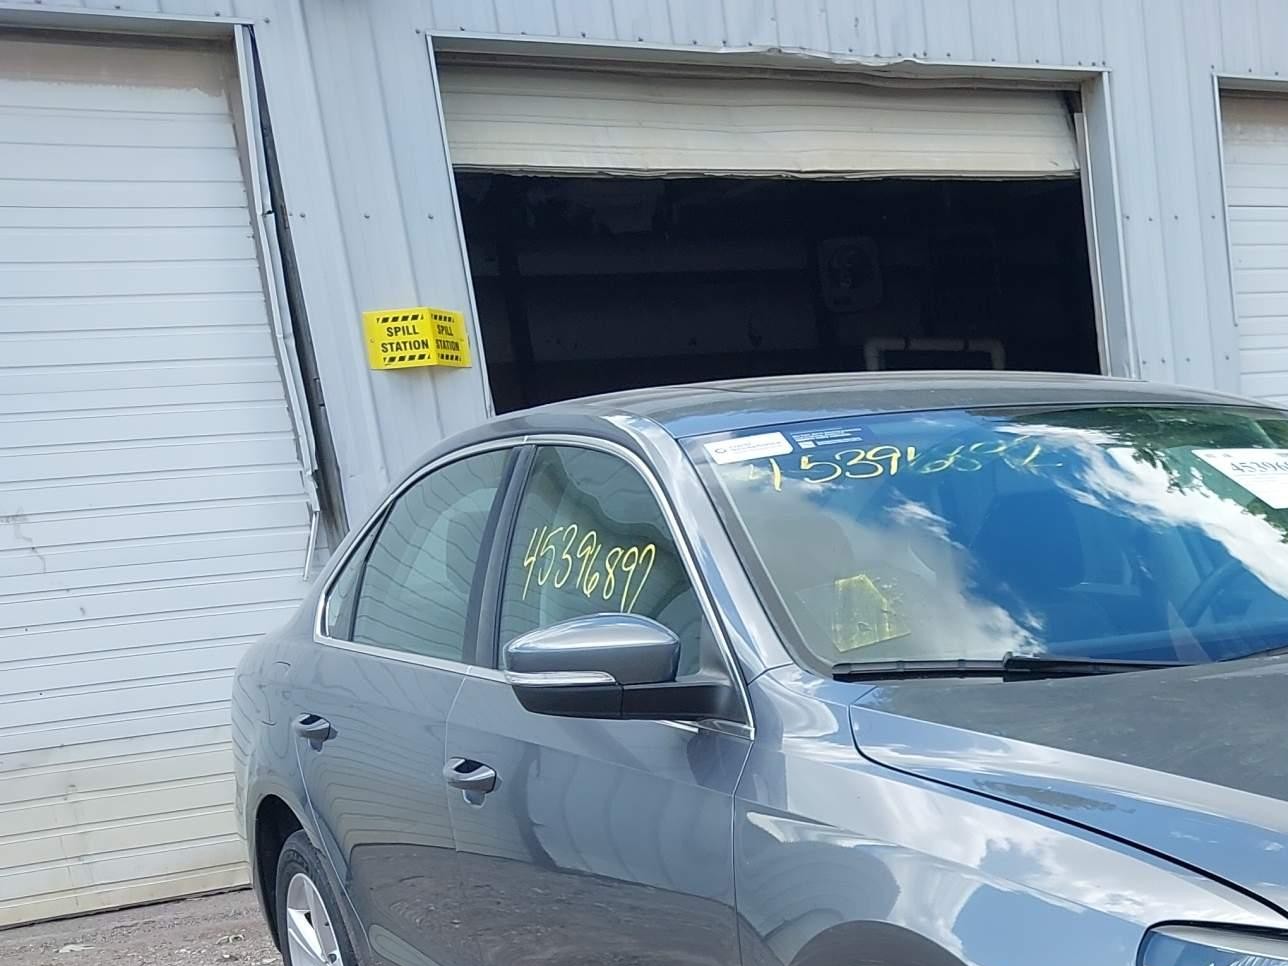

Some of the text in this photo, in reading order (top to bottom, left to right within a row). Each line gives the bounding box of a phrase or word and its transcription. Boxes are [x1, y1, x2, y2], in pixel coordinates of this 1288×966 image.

[386, 324, 419, 338] SPILL
[436, 324, 454, 337] SPILL
[381, 338, 430, 354] STATION
[435, 338, 460, 352] STATION
